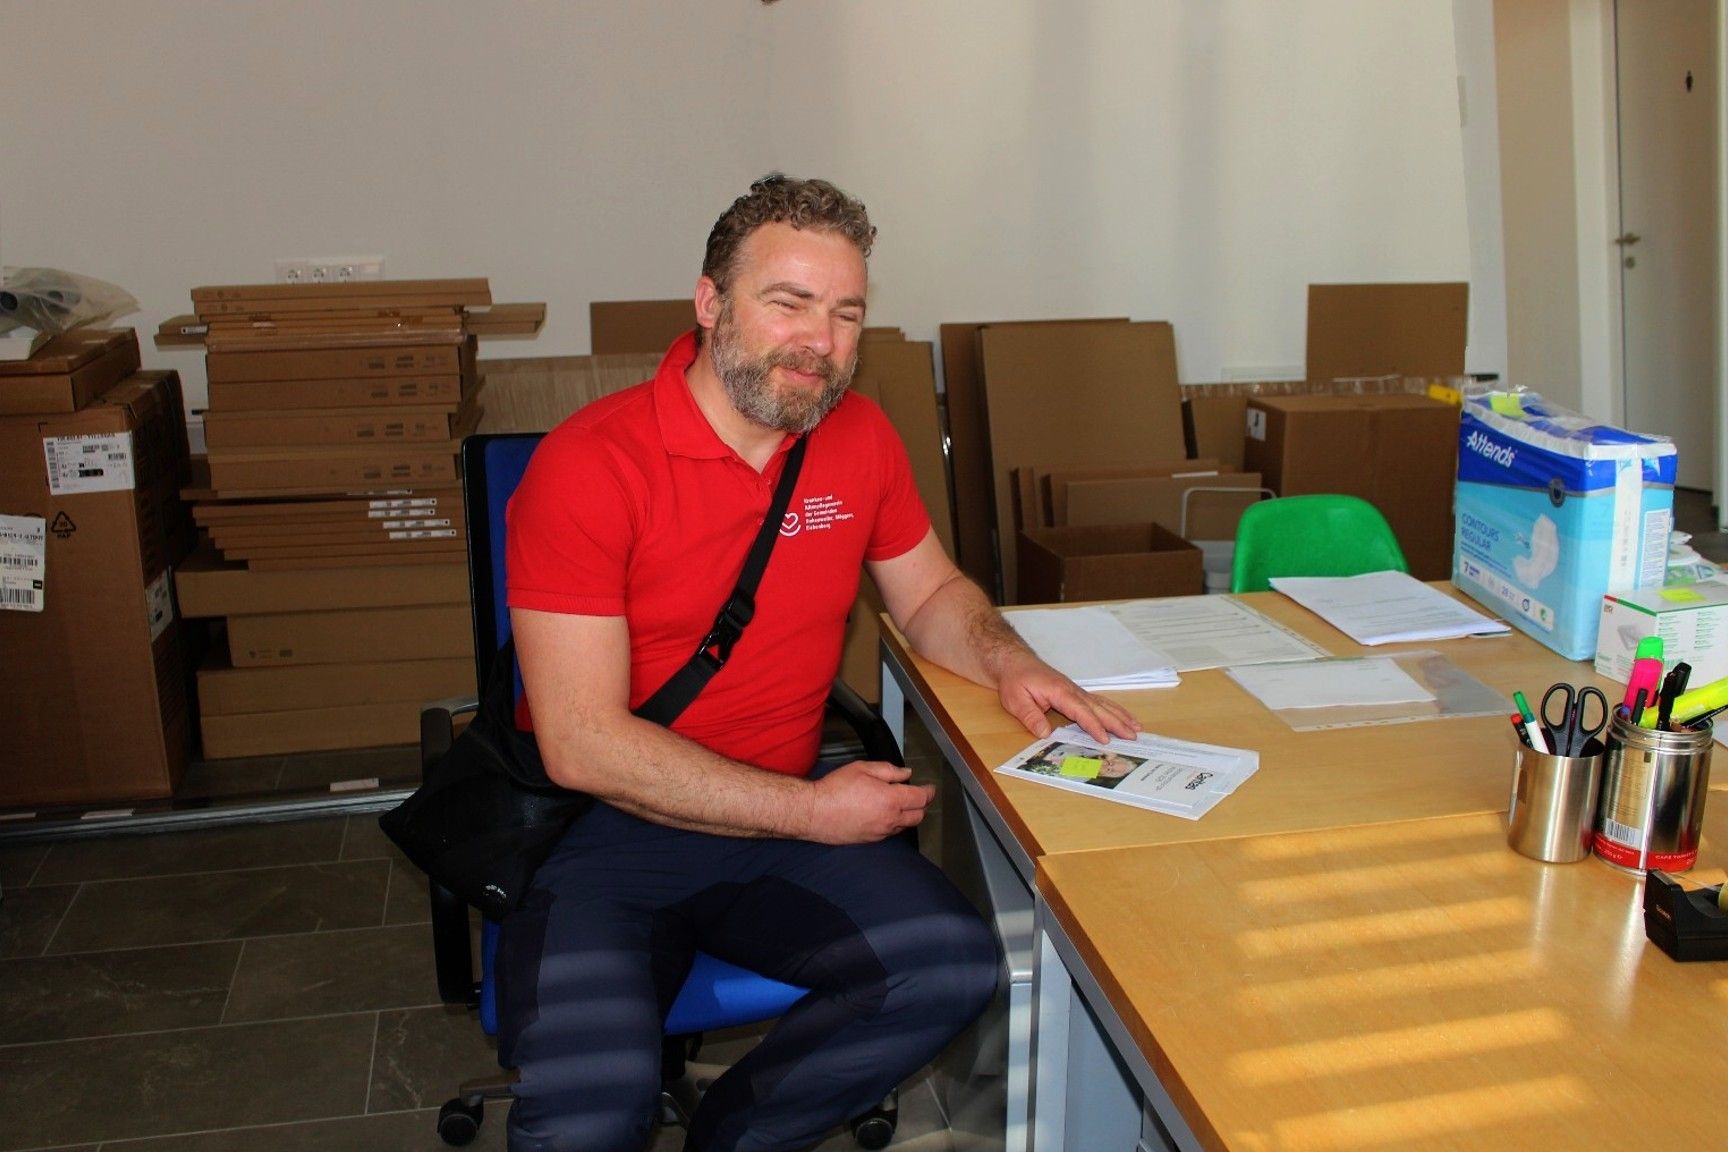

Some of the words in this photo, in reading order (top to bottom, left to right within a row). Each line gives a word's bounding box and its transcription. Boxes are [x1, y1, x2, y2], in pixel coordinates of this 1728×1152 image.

[1466, 430, 1516, 468] Attends
[1461, 512, 1501, 542] CONTOURS
[1461, 526, 1492, 550] REGULAR
